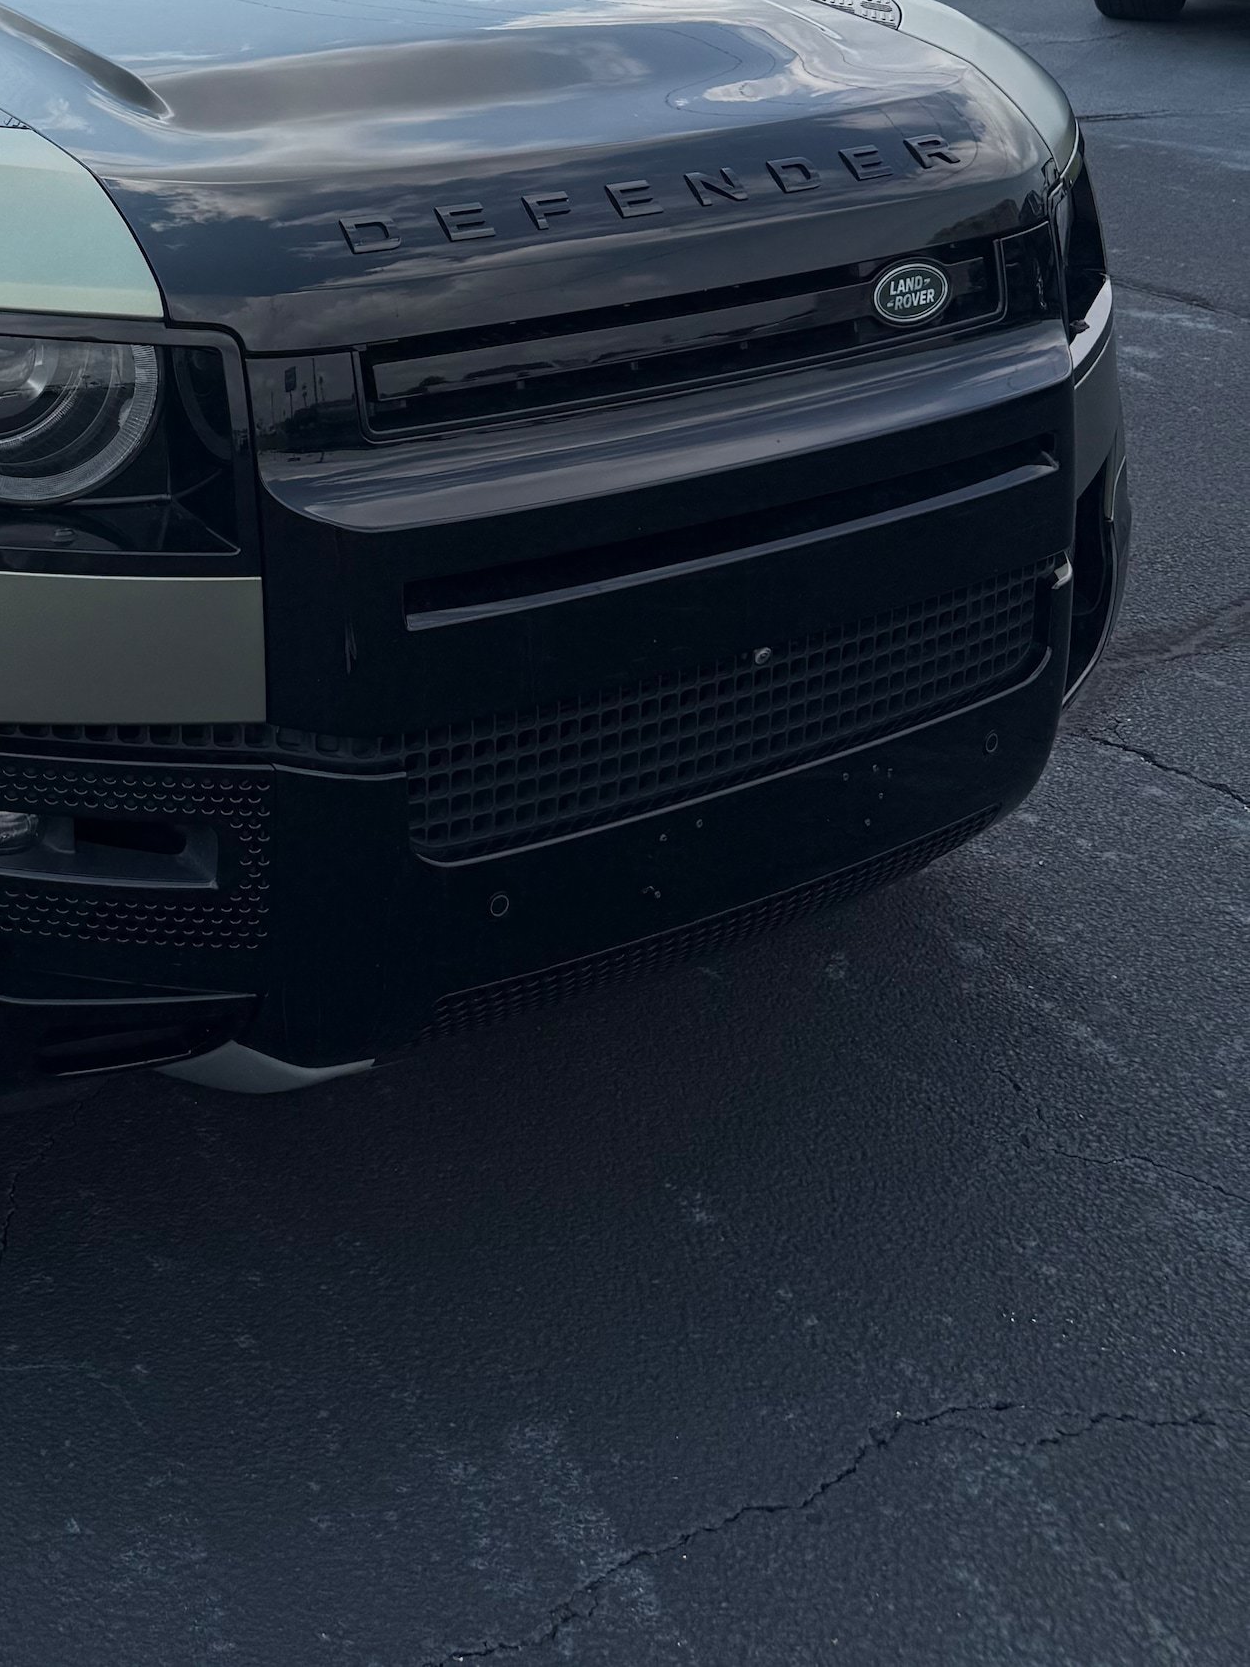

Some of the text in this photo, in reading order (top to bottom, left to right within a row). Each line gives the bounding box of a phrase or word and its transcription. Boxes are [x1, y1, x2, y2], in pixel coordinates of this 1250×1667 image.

[338, 133, 962, 255] DEFENDER
[890, 275, 923, 296] LAND
[894, 288, 935, 311] ROVER
